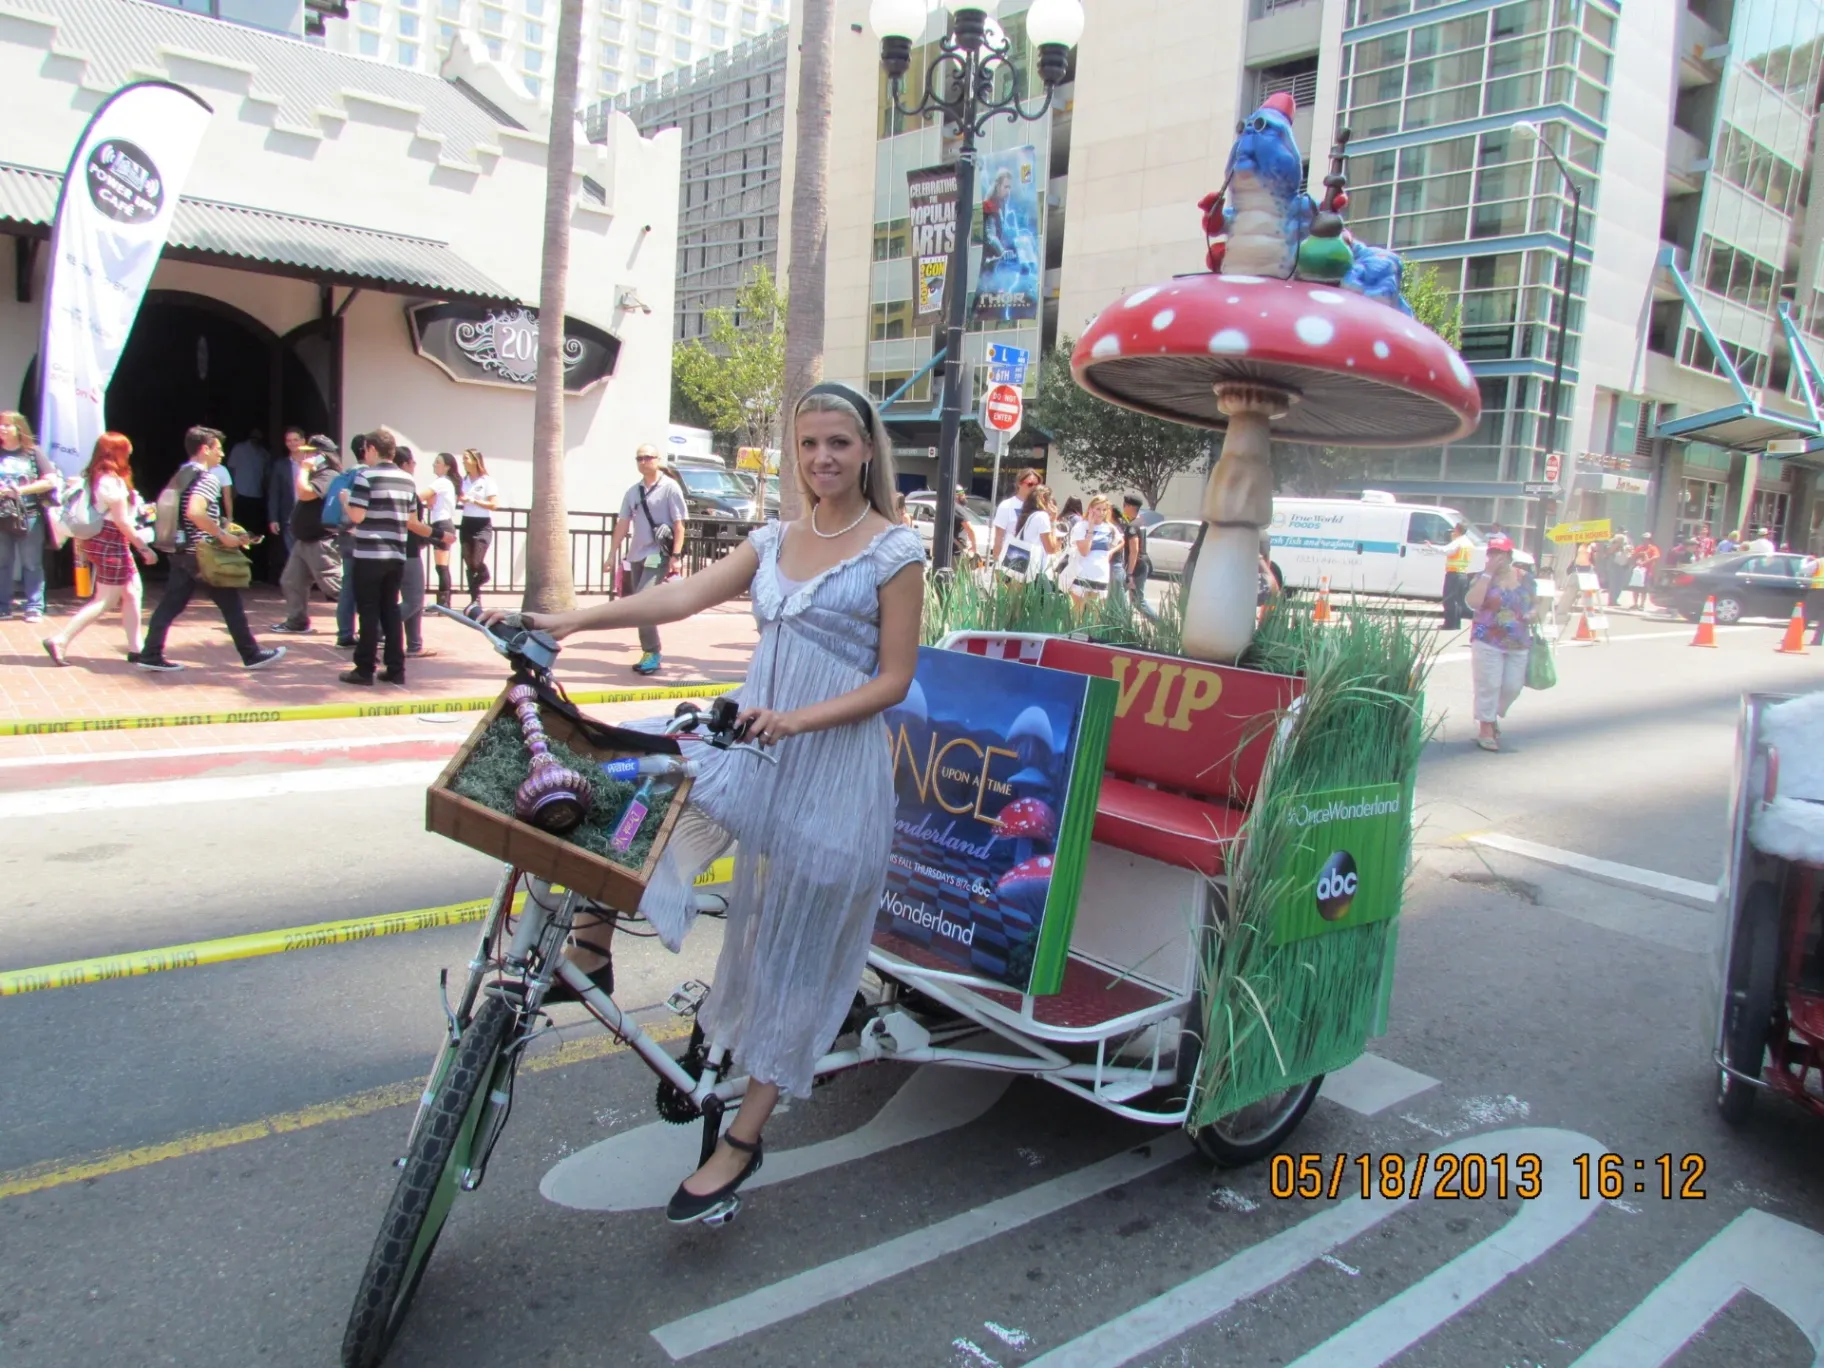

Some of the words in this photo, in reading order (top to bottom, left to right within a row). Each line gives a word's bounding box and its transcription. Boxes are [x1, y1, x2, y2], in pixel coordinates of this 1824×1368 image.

[88, 161, 133, 200] POWER
[909, 176, 958, 198] CELEBRATING
[912, 221, 957, 257] ARTS
[1001, 348, 1008, 362] L
[995, 368, 1010, 382] 6TH
[992, 392, 1002, 400] DO
[1004, 394, 1017, 403] NOT
[993, 412, 1013, 422] ENTER
[1288, 521, 1321, 530] FOODS
[1291, 513, 1311, 522] True
[1314, 514, 1344, 524] World
[1284, 536, 1301, 547] fish
[1110, 655, 1223, 732] VIP
[886, 723, 1018, 827] NCE
[941, 765, 970, 783] UPON
[972, 776, 980, 787] A
[987, 778, 1013, 796] TIME
[898, 855, 913, 870] FALL
[914, 861, 955, 885] THURSDAYS
[971, 881, 991, 898] abc
[1316, 867, 1358, 900] abc
[880, 889, 976, 946] Wonderland
